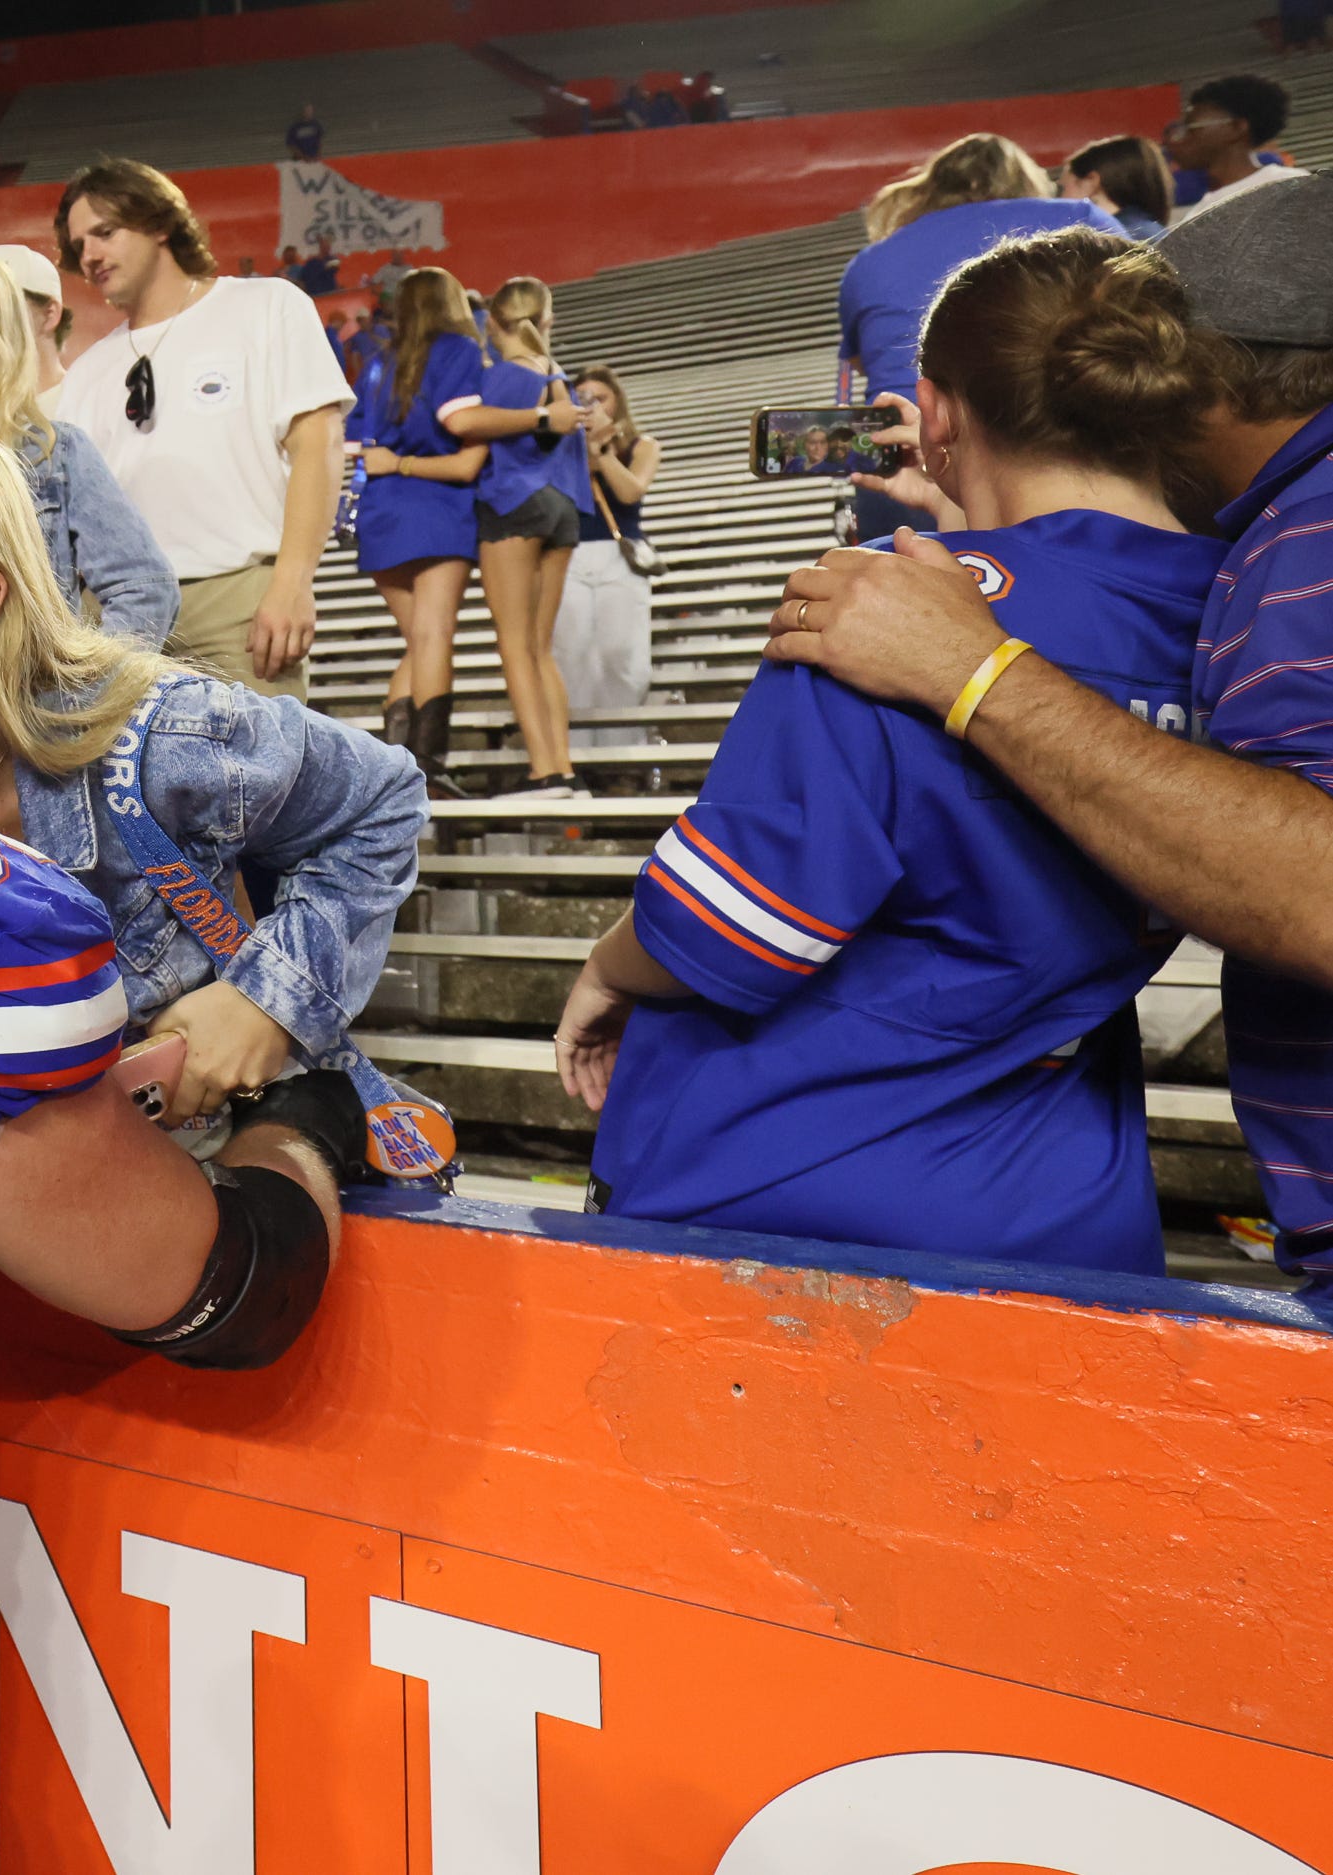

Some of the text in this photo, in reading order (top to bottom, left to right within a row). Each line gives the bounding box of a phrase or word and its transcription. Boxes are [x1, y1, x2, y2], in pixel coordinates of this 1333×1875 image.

[368, 1110, 417, 1140] WON'T
[382, 1129, 425, 1155] BACK
[390, 1144, 440, 1171] DOWN
